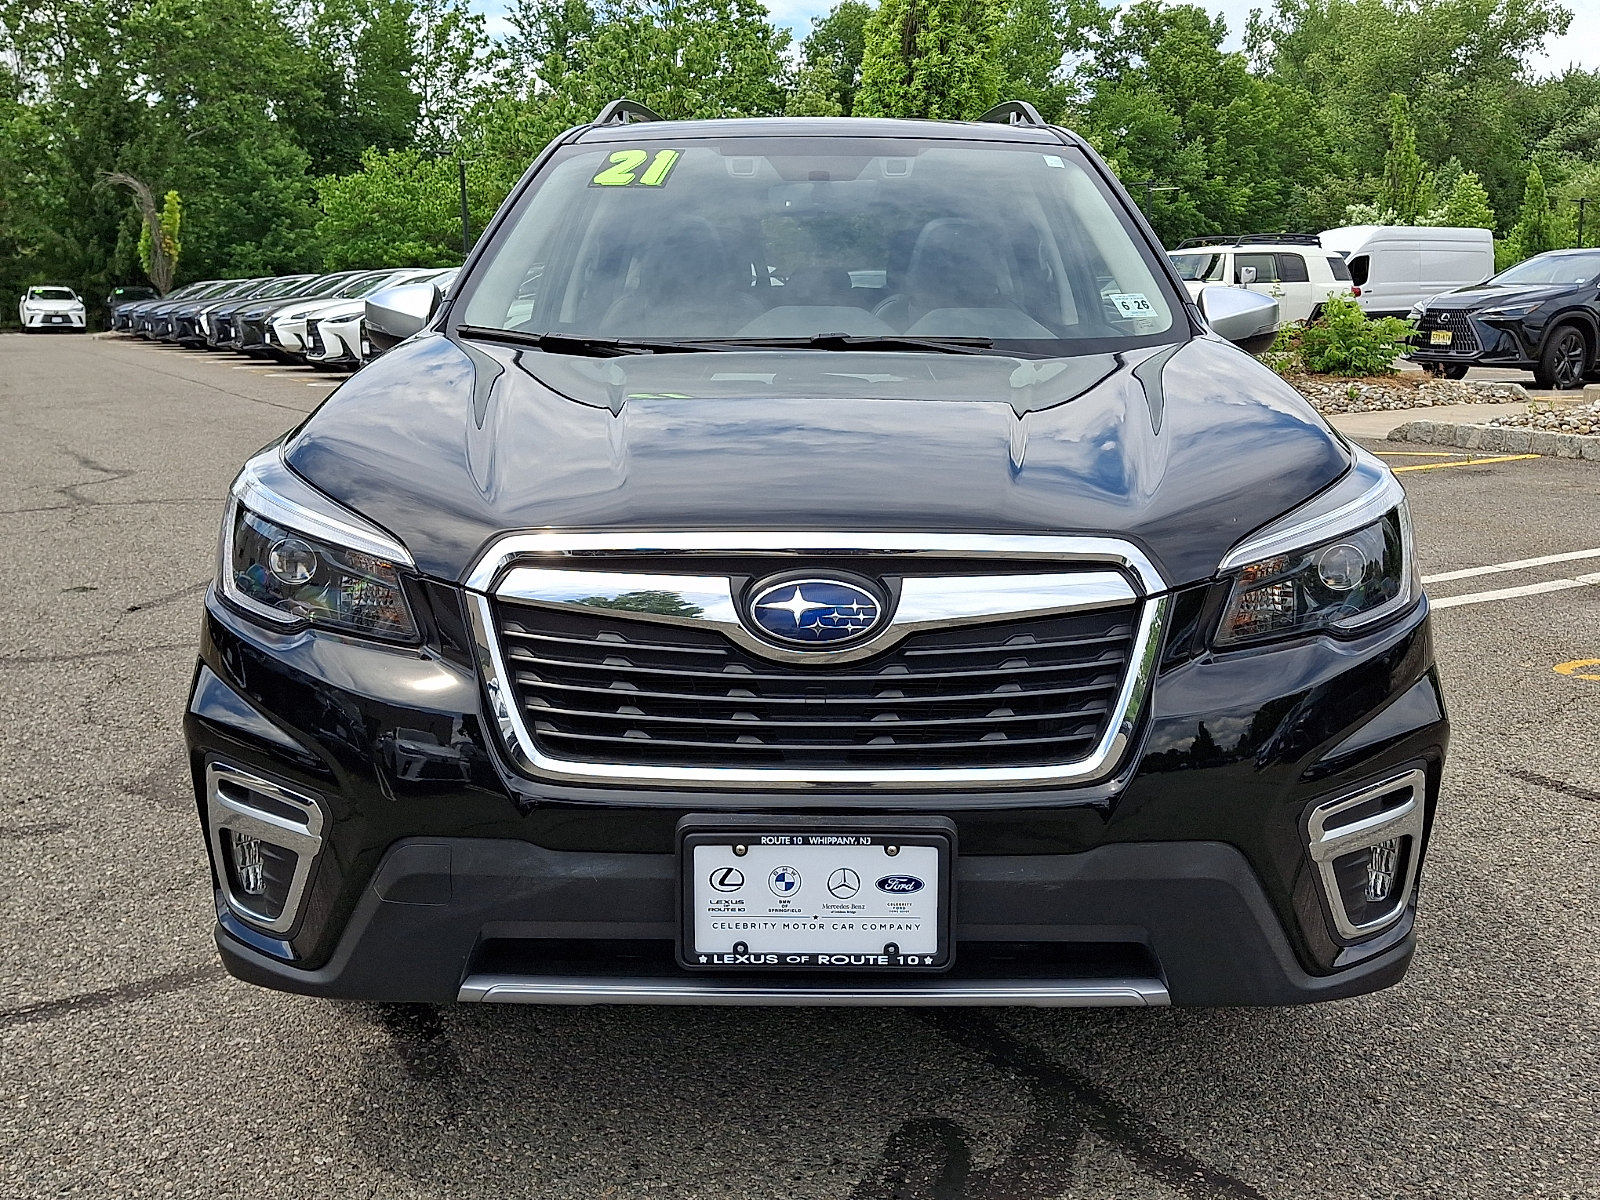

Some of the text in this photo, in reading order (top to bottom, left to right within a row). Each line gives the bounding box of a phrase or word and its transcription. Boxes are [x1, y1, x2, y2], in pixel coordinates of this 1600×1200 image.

[593, 149, 680, 186] 21
[1121, 299, 1150, 311] 6 26
[761, 836, 872, 846] ROUTE 10 WHIPPANY, NJ
[884, 877, 916, 891] Ford
[711, 922, 777, 930] CELEBRITY
[831, 923, 855, 931] CAR
[861, 923, 921, 931] COMPANY
[713, 954, 919, 965] LEXUS OF ROUTE 10
